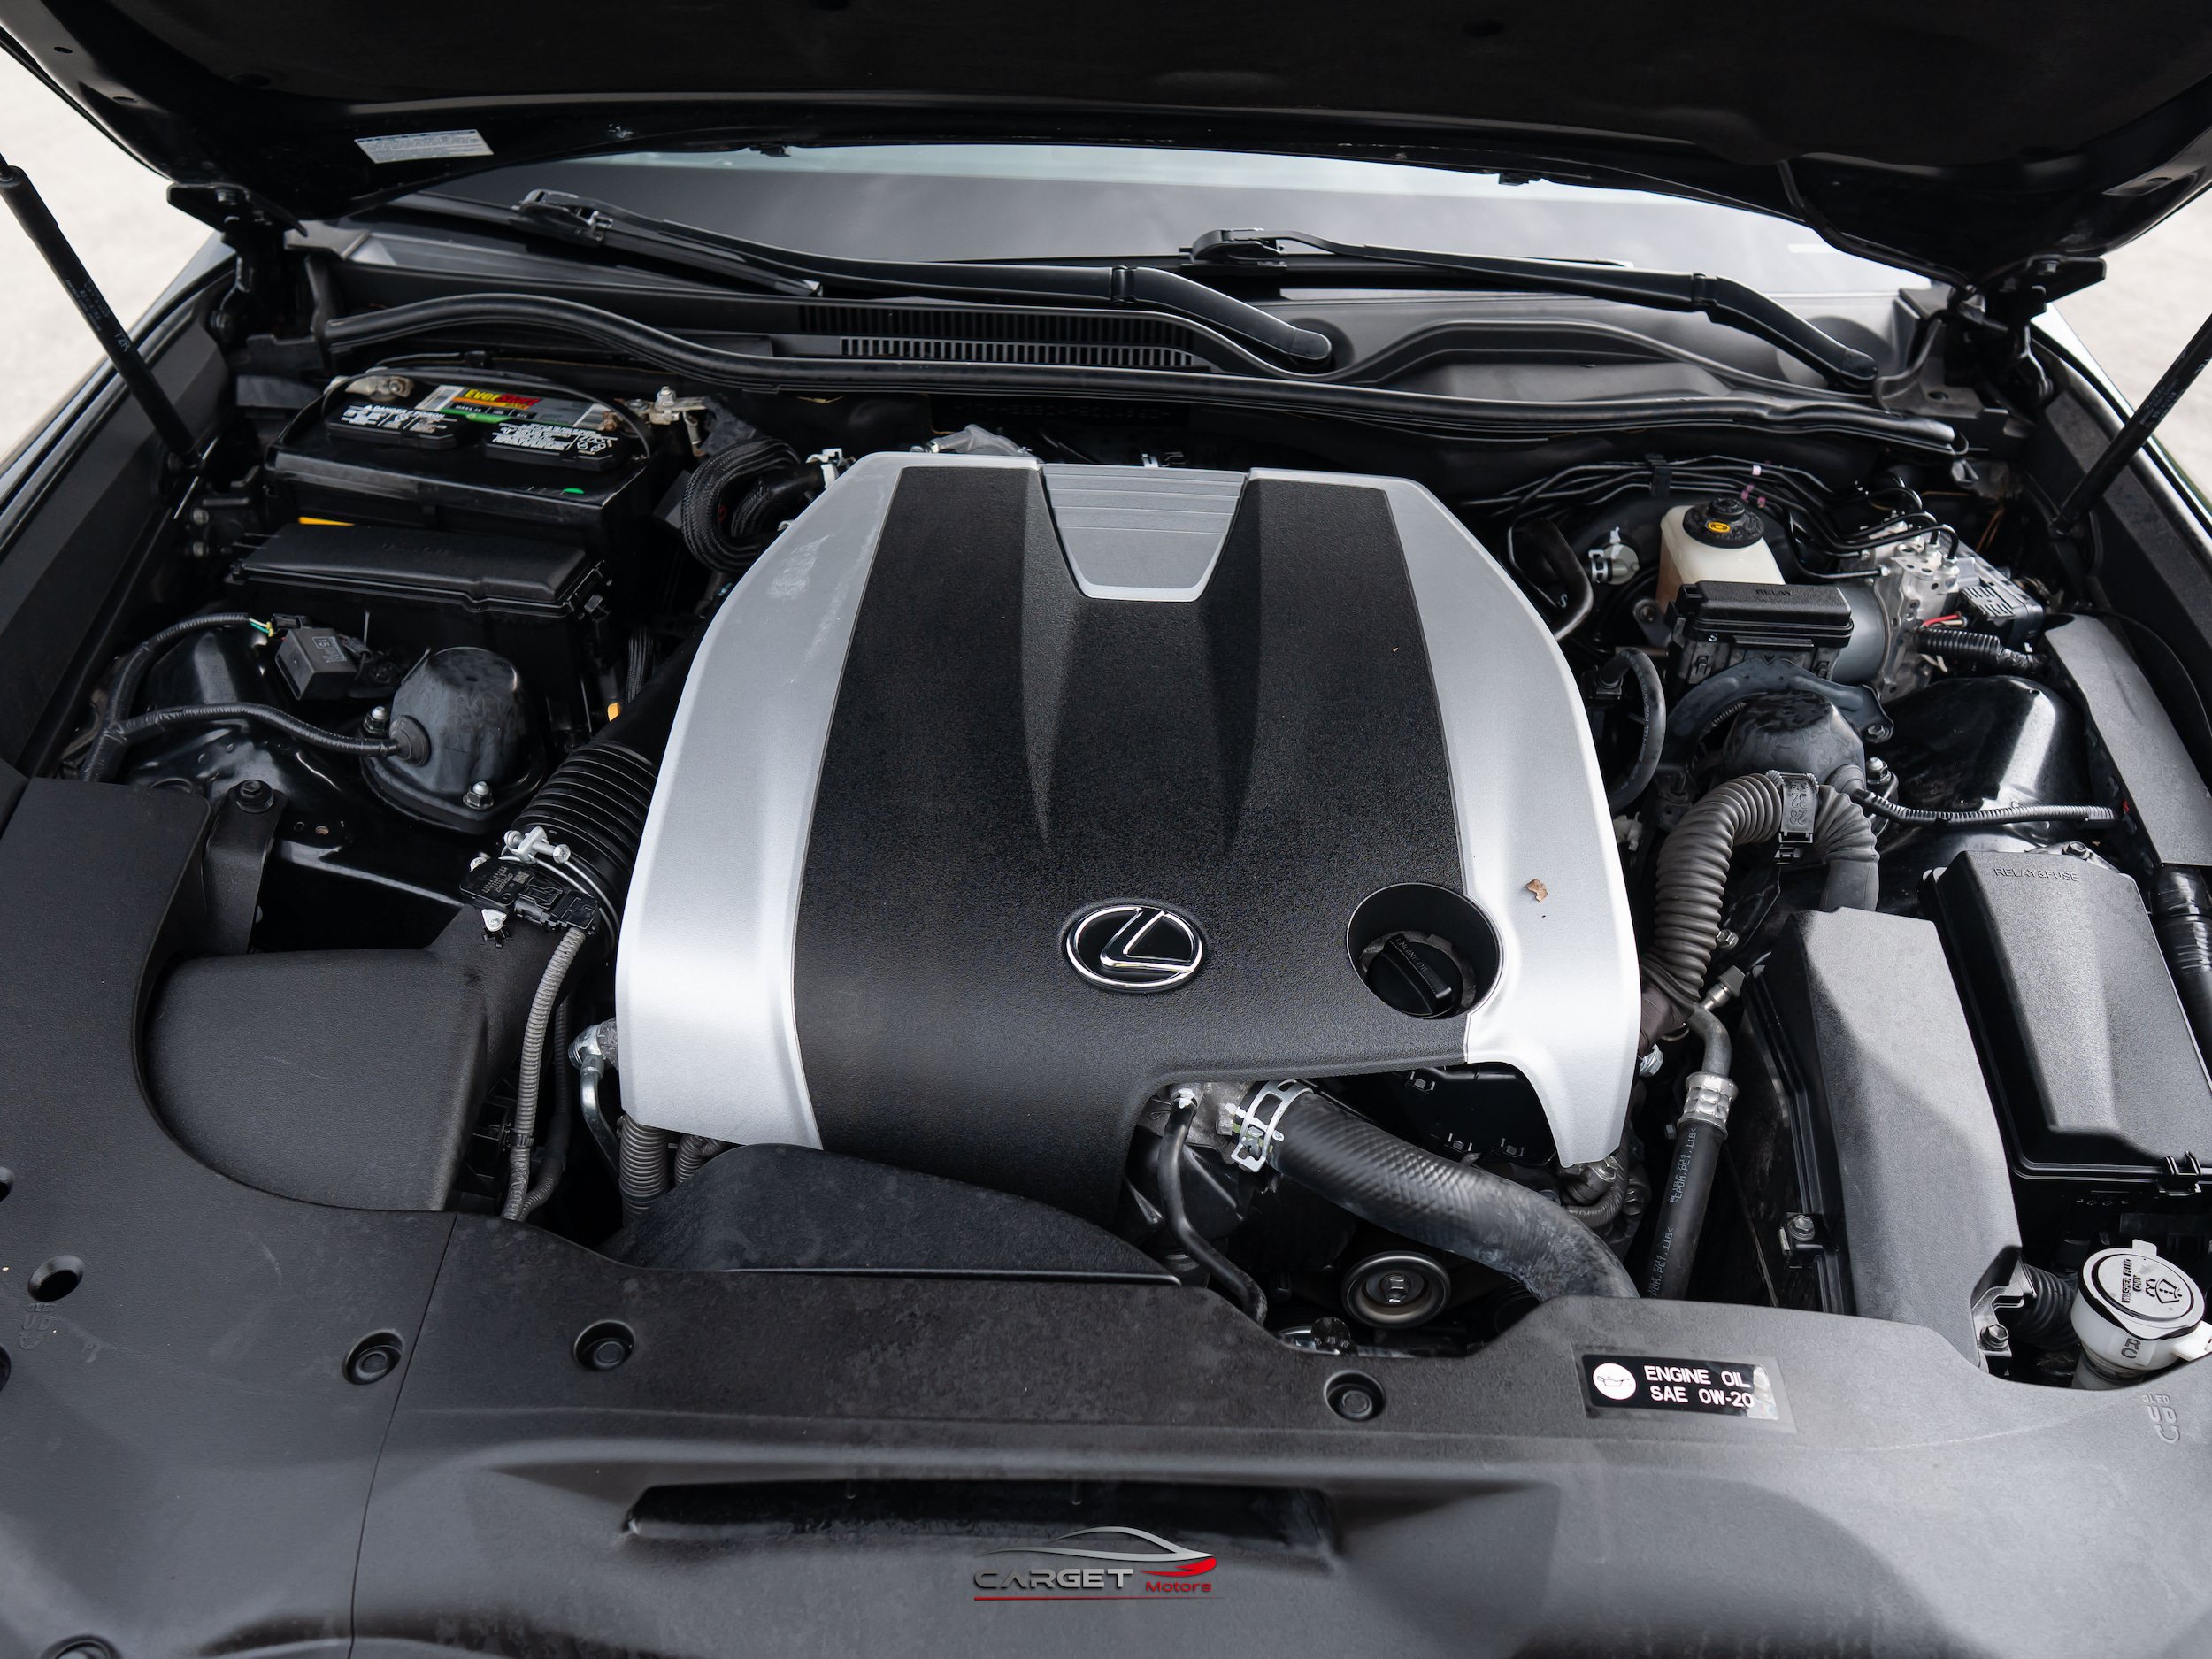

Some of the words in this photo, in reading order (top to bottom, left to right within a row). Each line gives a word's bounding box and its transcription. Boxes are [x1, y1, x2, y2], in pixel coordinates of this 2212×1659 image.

[1994, 867, 2080, 881] RELAY&FUSE
[1643, 1365, 1711, 1386] ENGINE
[1720, 1371, 1751, 1388] OIL
[1649, 1385, 1688, 1402] SAE
[1698, 1388, 1755, 1409] 0W-20
